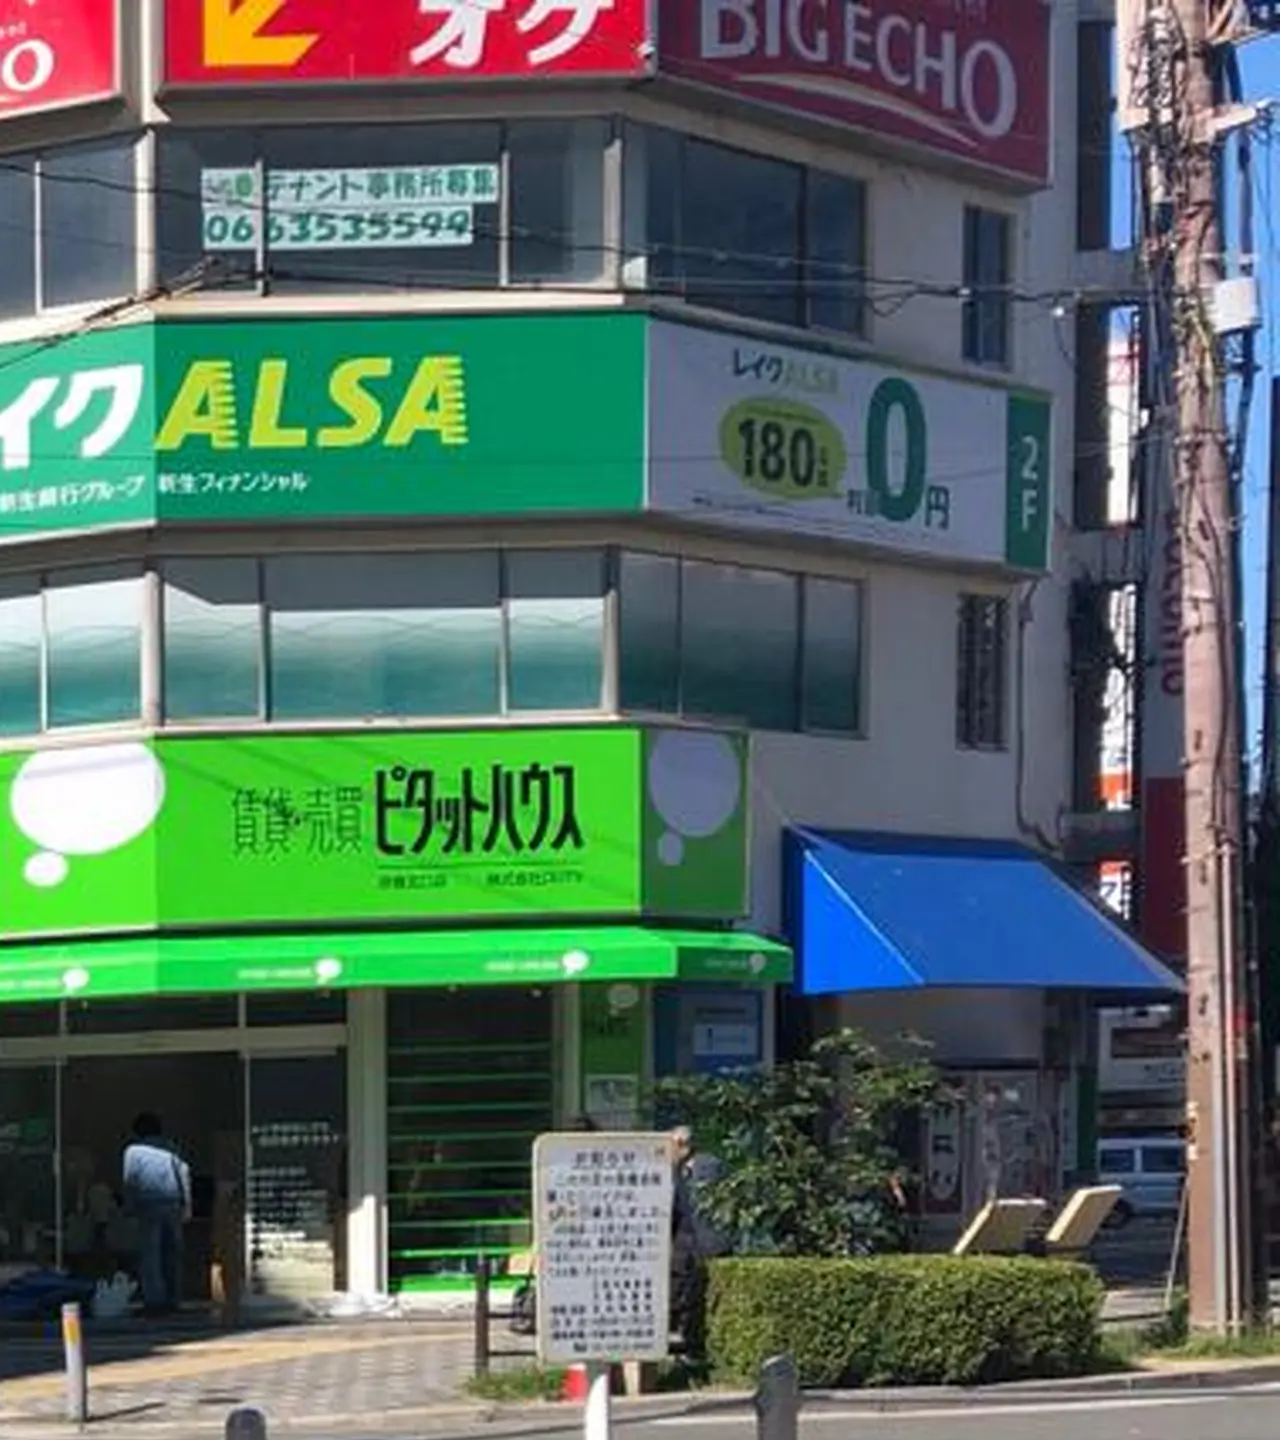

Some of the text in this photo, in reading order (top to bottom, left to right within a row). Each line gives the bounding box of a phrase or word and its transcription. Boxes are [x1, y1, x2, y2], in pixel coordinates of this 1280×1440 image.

[700, 0, 1017, 138] BIG ECHO
[154, 356, 469, 450] ALSA
[738, 418, 816, 488] 180
[375, 762, 585, 855] ピタットハウス
